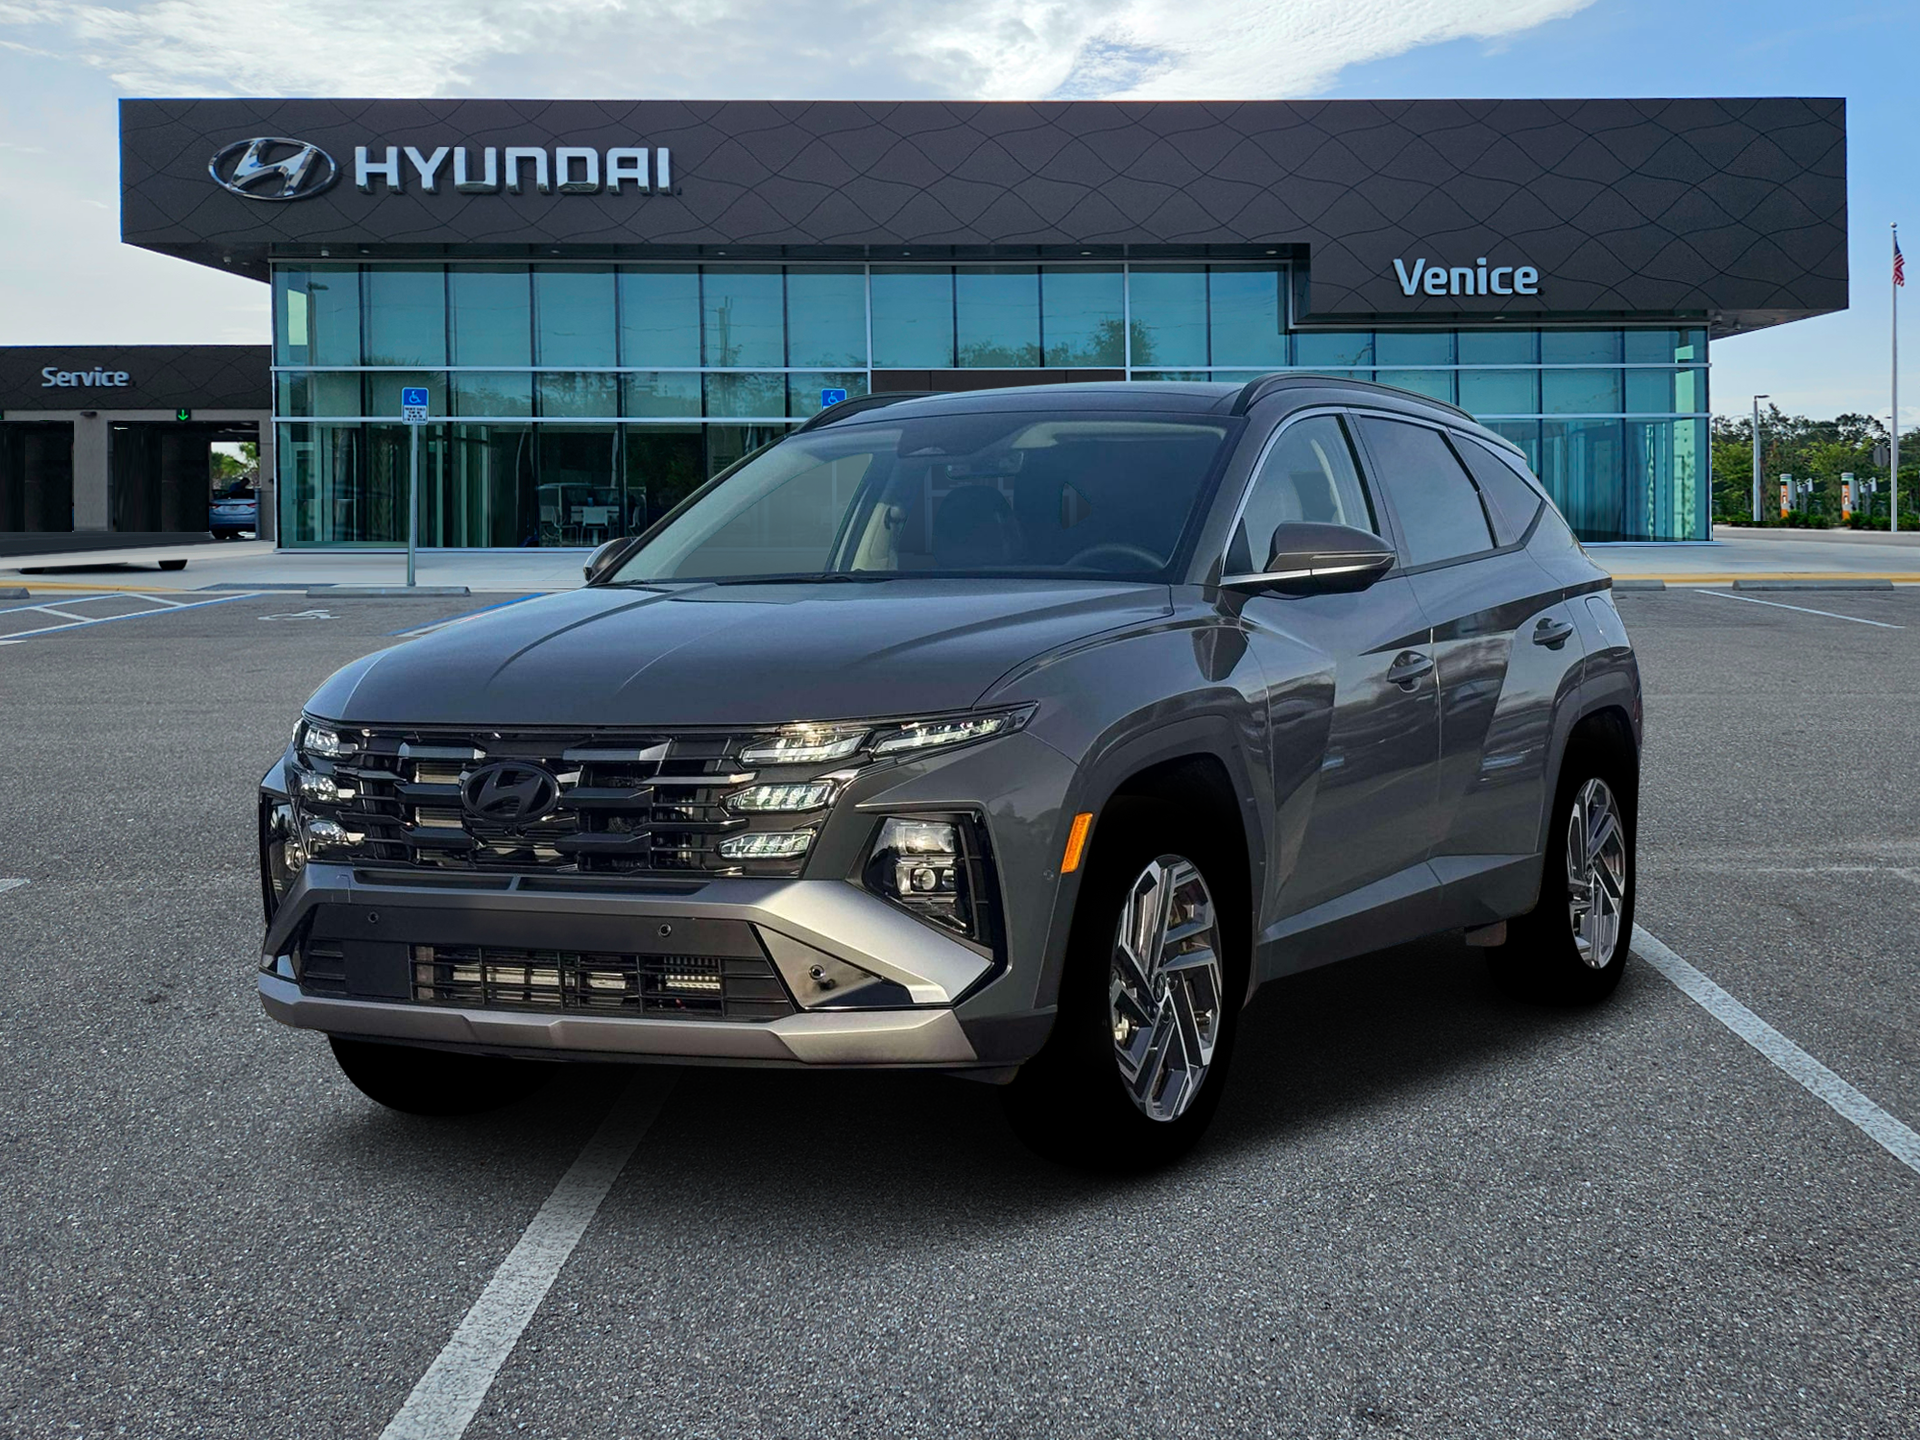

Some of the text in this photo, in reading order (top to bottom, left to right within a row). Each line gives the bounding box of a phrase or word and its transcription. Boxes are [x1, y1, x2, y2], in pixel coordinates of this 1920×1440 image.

[354, 146, 672, 194] HYUNDAI
[1392, 257, 1539, 296] Venice
[41, 366, 130, 387] Service
